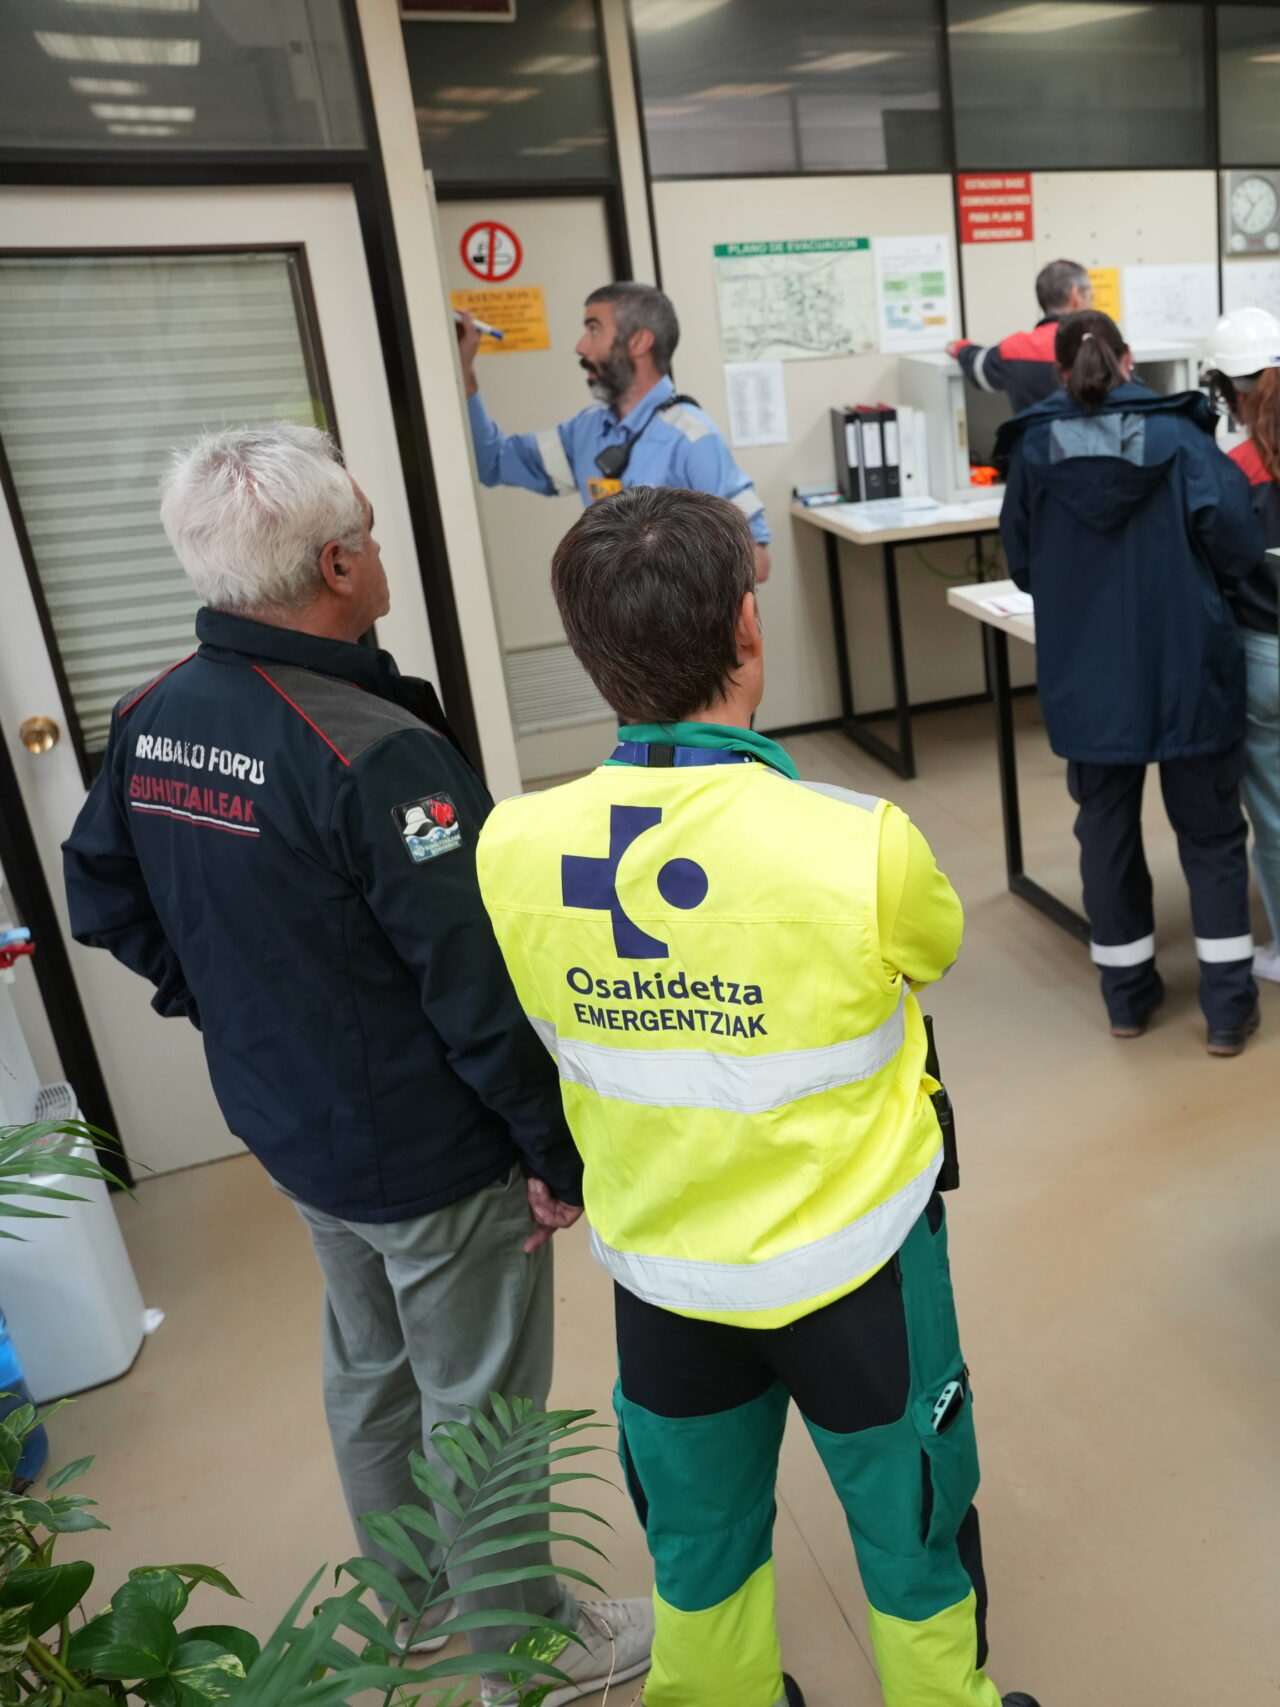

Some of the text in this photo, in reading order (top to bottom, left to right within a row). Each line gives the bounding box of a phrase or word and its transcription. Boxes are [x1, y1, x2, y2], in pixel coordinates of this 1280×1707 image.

[135, 734, 265, 785] ARABAKO FORU
[566, 966, 764, 1006] Osakidetza
[574, 1003, 768, 1039] EMERGENTZIAK
